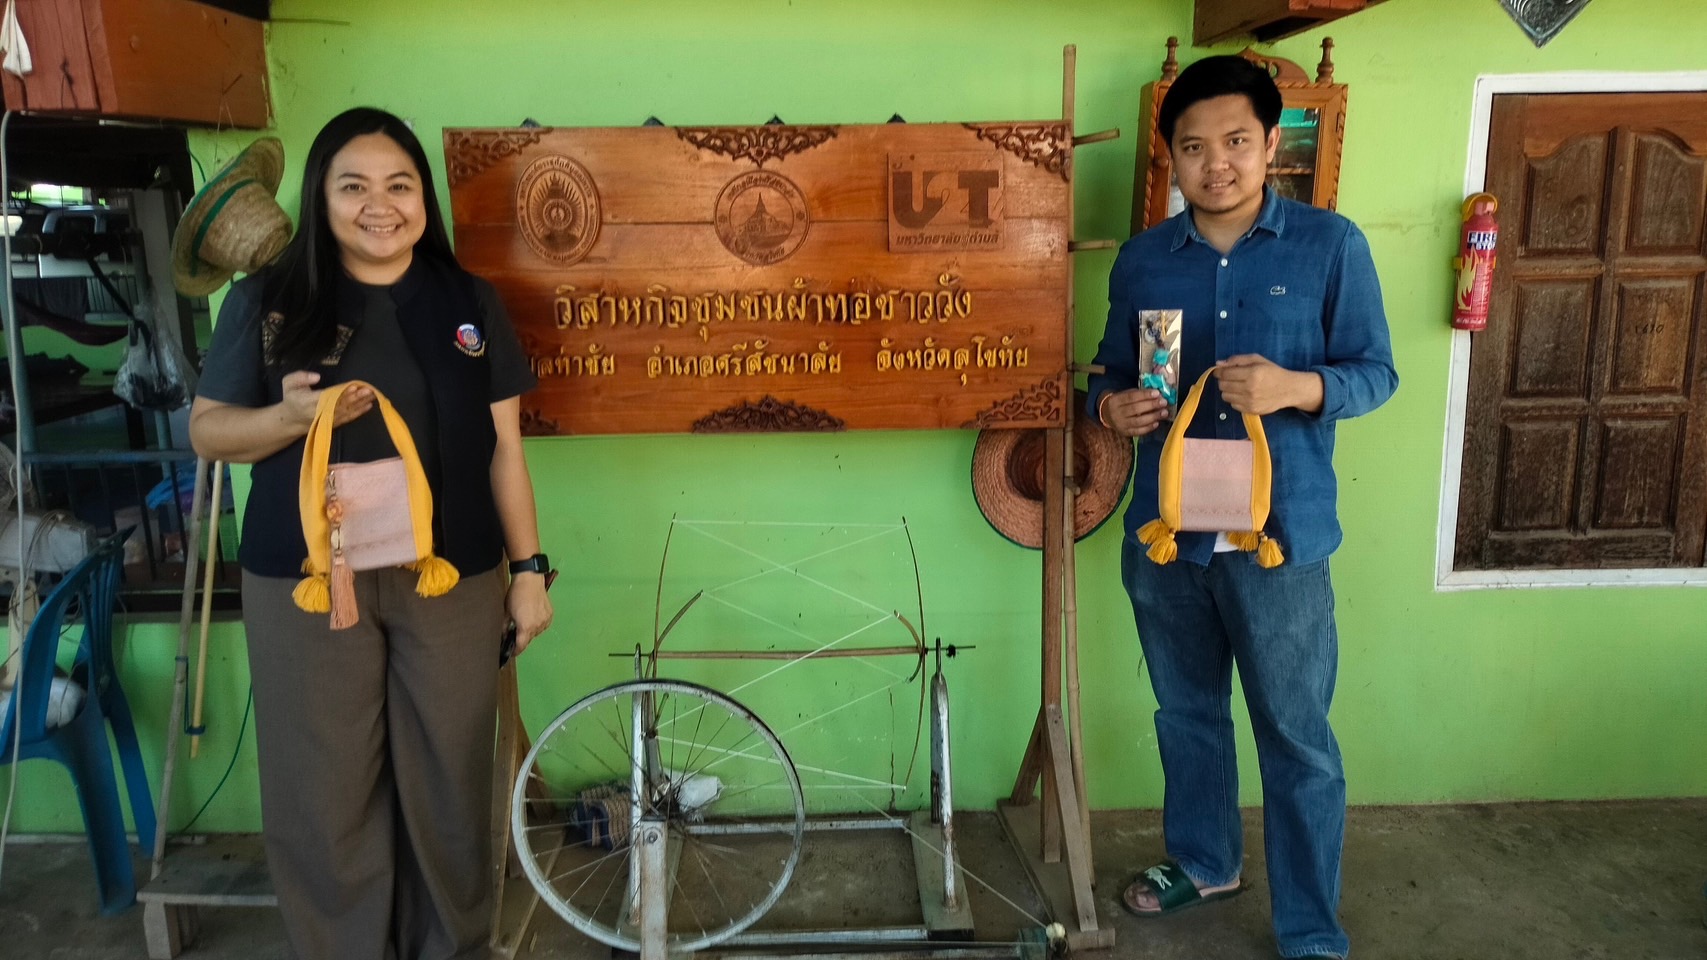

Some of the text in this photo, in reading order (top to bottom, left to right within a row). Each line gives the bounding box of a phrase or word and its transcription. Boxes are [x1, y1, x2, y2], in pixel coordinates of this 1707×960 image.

[1468, 231, 1497, 242] FIRE
[554, 273, 971, 342] วิสาหกิจชุมชนผ้าทอชาววัง
[647, 339, 842, 378] อำเภอศรีสัชนาลัย
